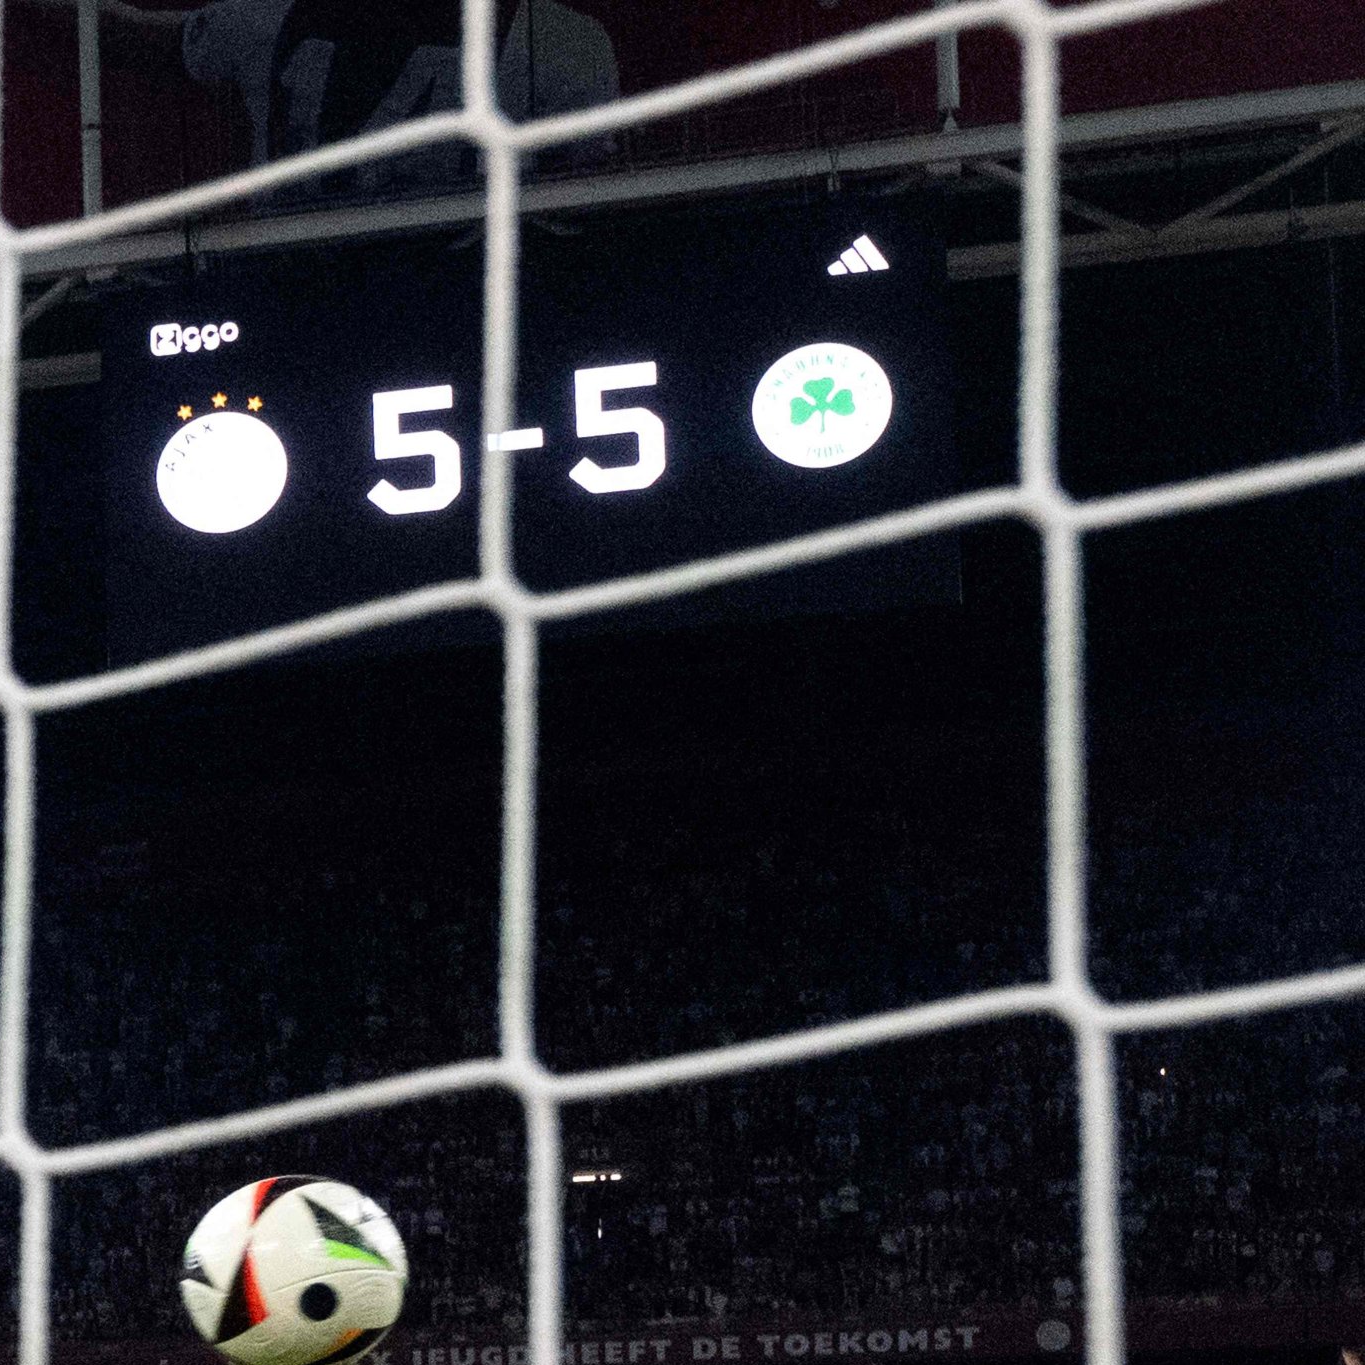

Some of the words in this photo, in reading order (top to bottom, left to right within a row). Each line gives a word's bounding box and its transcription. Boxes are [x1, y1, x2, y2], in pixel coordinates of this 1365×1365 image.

[165, 422, 214, 472] AJAX
[690, 1335, 742, 1361] DE
[755, 1325, 981, 1358] TOEKOMST
